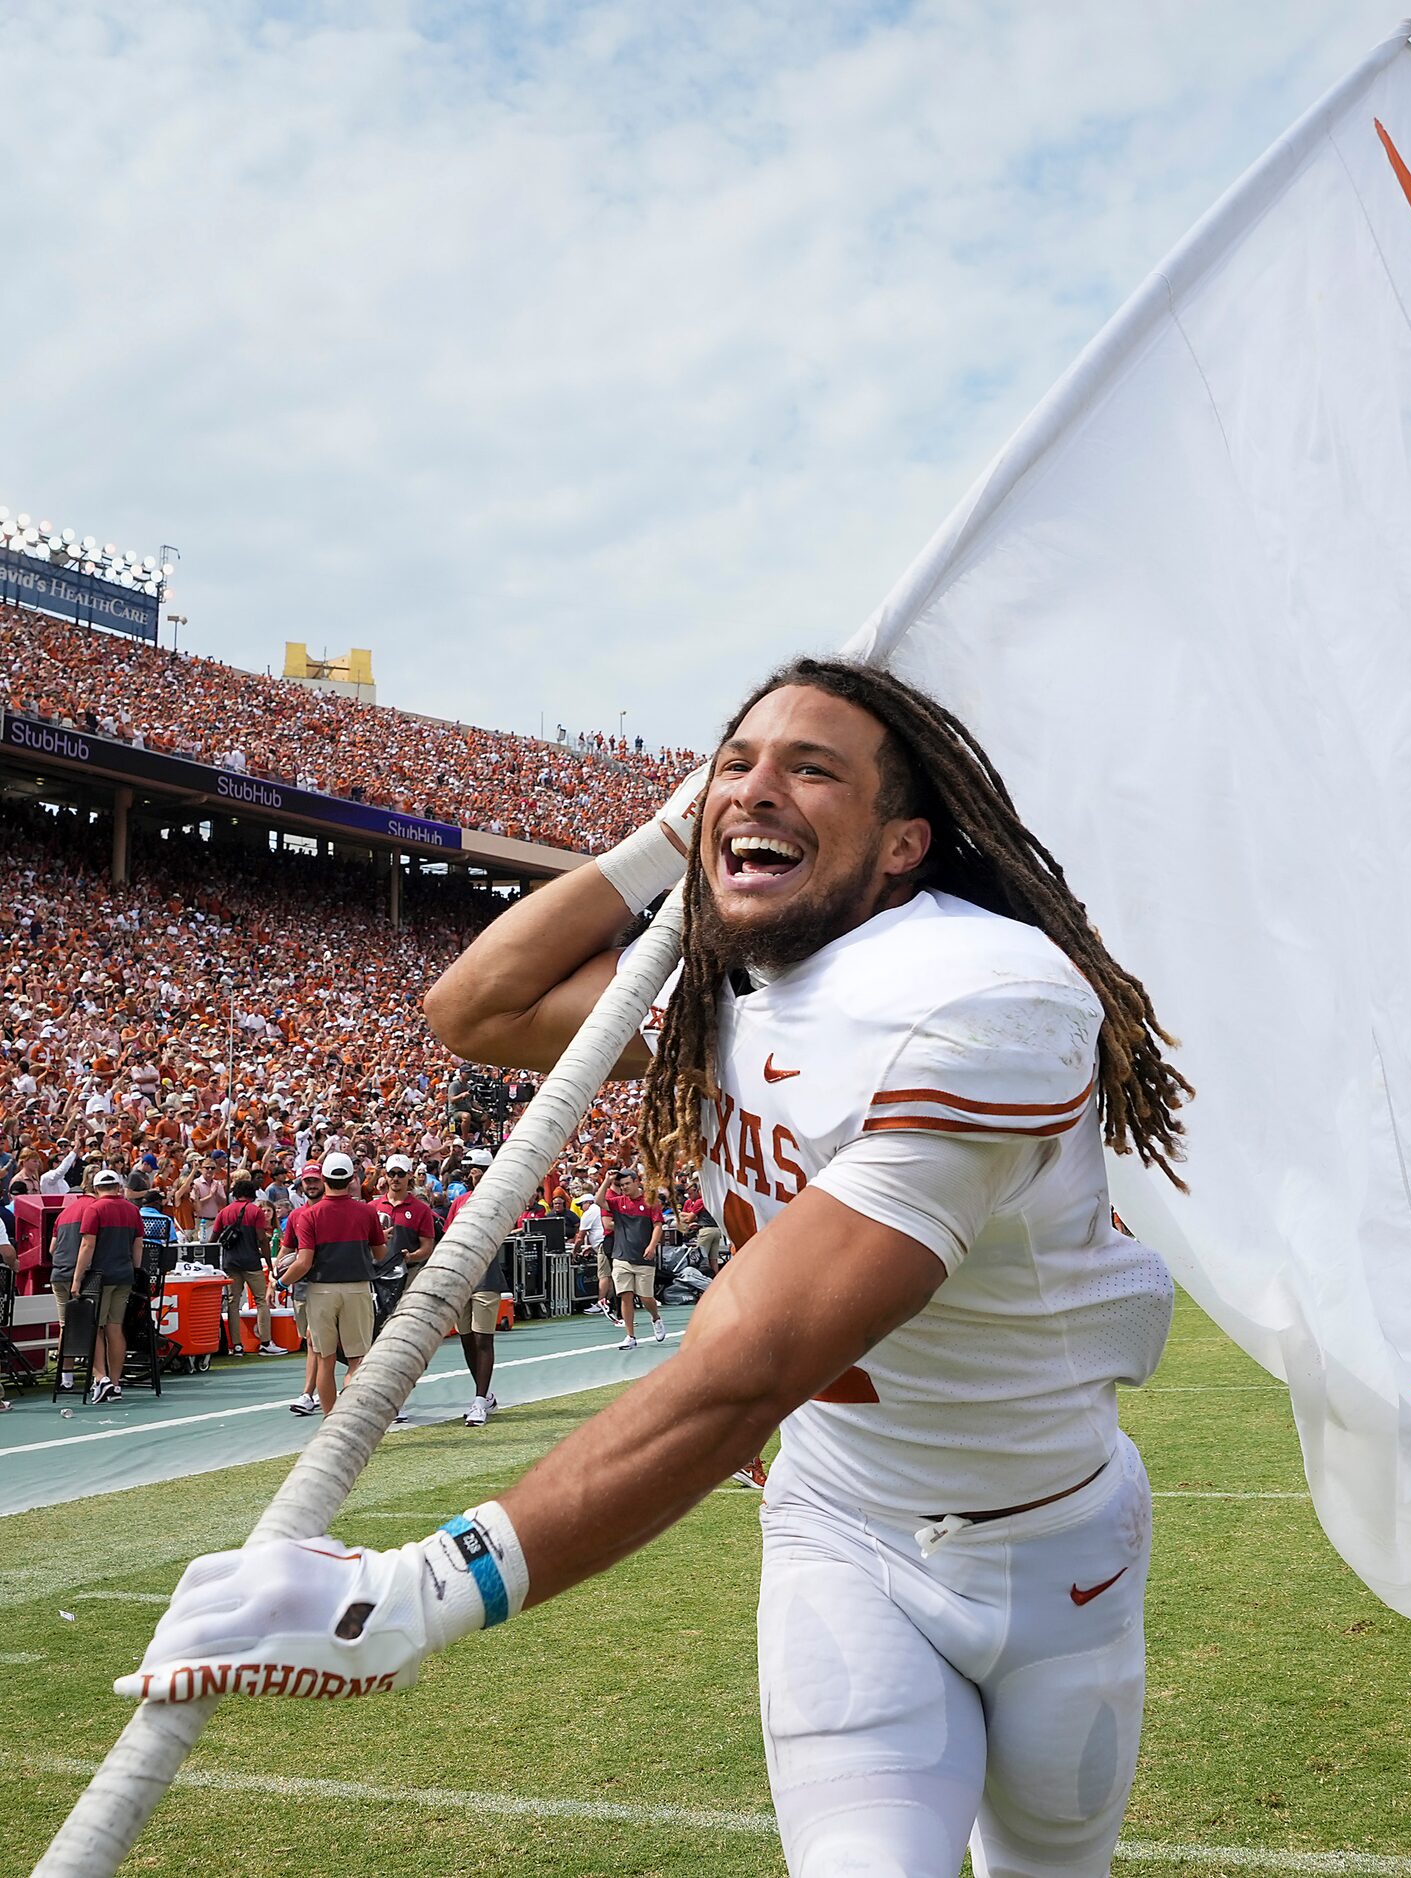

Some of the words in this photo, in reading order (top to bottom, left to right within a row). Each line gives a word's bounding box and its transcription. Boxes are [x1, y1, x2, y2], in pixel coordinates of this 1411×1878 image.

[11, 722, 90, 760] StubHub
[217, 775, 282, 808] StubHub
[702, 1086, 808, 1204] XAS
[141, 1663, 399, 1704] LONGHORNS
